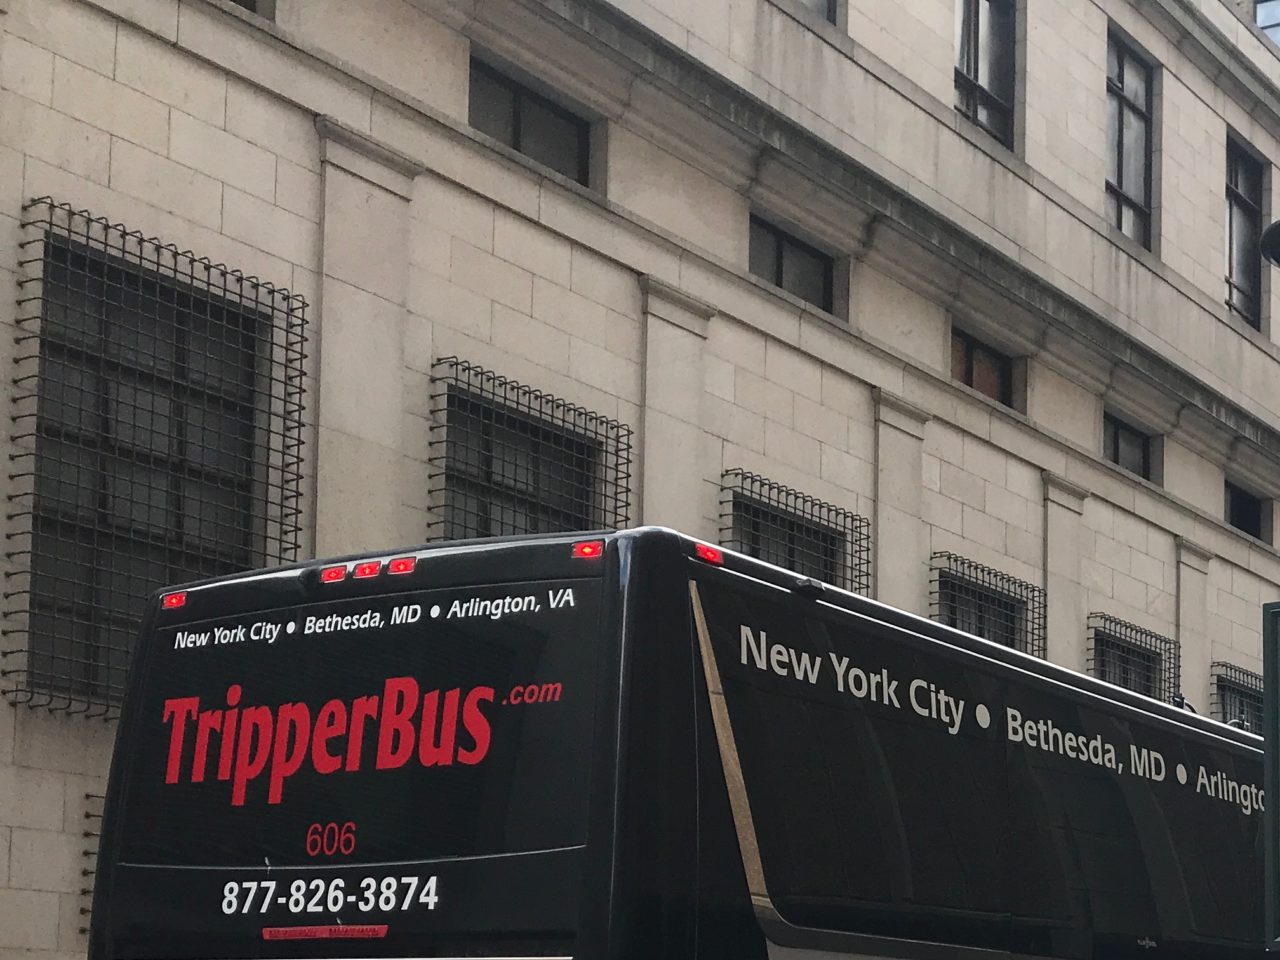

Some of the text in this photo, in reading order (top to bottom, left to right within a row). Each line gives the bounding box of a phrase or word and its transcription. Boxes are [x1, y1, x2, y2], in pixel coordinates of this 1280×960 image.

[174, 588, 575, 649] New York City Bethesda, MD Arlington, VA
[740, 625, 1265, 815] New York City Bethesda, MD Arlingto
[306, 822, 357, 856] 606
[221, 876, 438, 915] 877-826-3874
